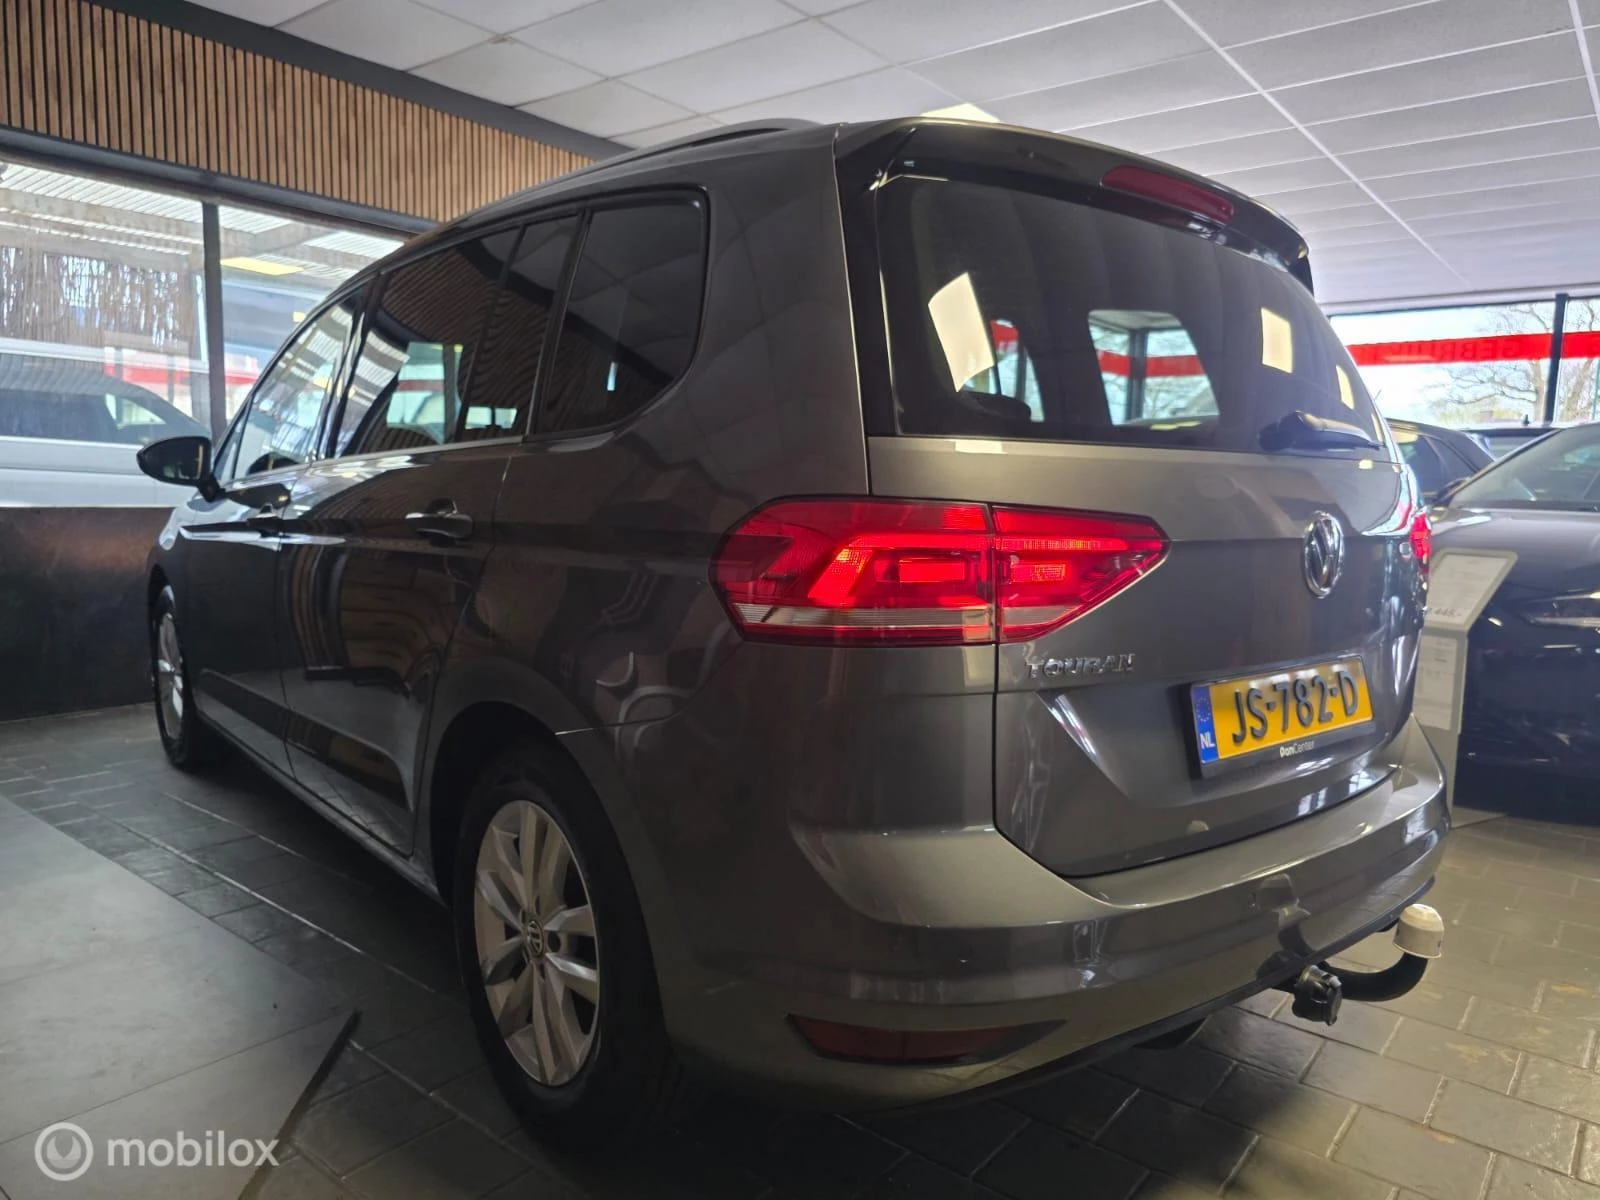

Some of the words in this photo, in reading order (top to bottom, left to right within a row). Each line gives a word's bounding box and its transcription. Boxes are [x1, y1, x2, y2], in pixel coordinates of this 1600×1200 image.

[1026, 652, 1136, 678] TOURAN
[1199, 732, 1216, 750] NL
[1231, 670, 1358, 745] JS-782-D
